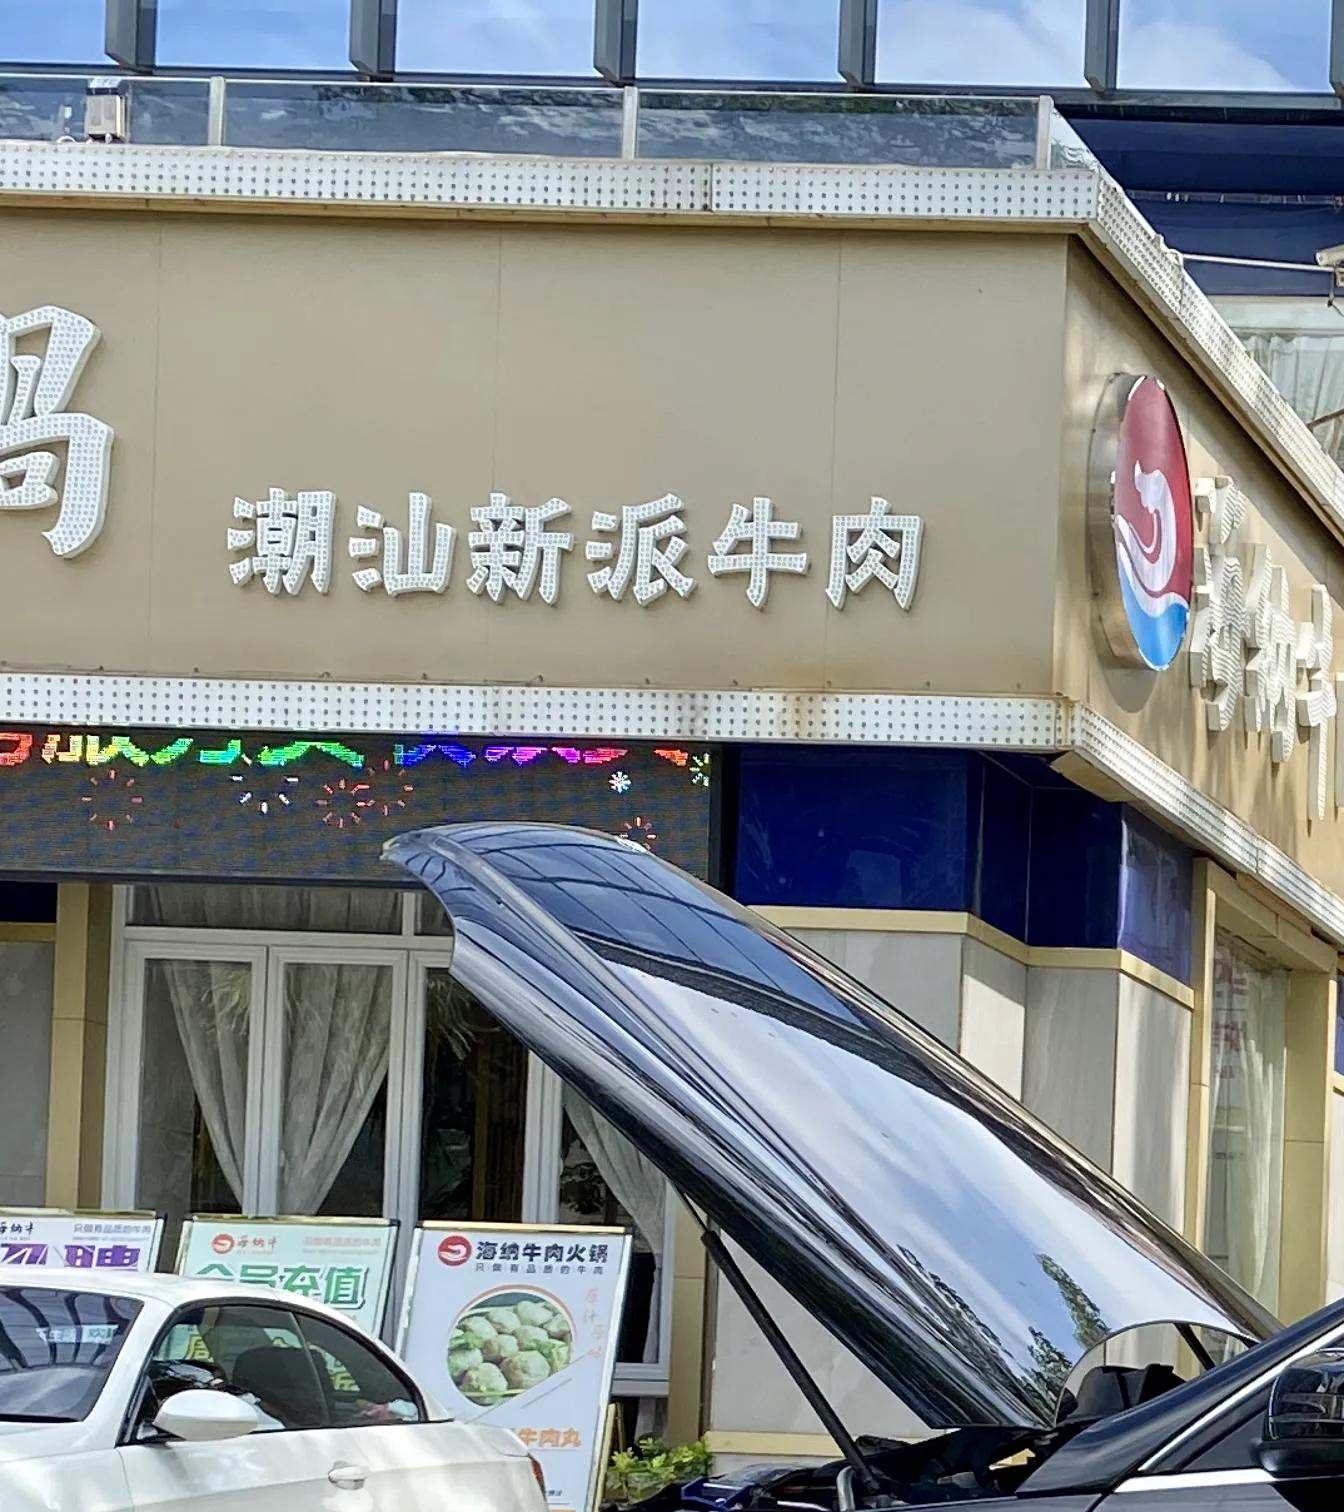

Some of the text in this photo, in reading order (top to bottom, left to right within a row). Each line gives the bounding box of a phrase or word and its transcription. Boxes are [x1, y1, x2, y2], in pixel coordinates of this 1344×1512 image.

[226, 487, 924, 611] 潮汕新派牛肉
[475, 1240, 609, 1264] 海纳牛肉火锅
